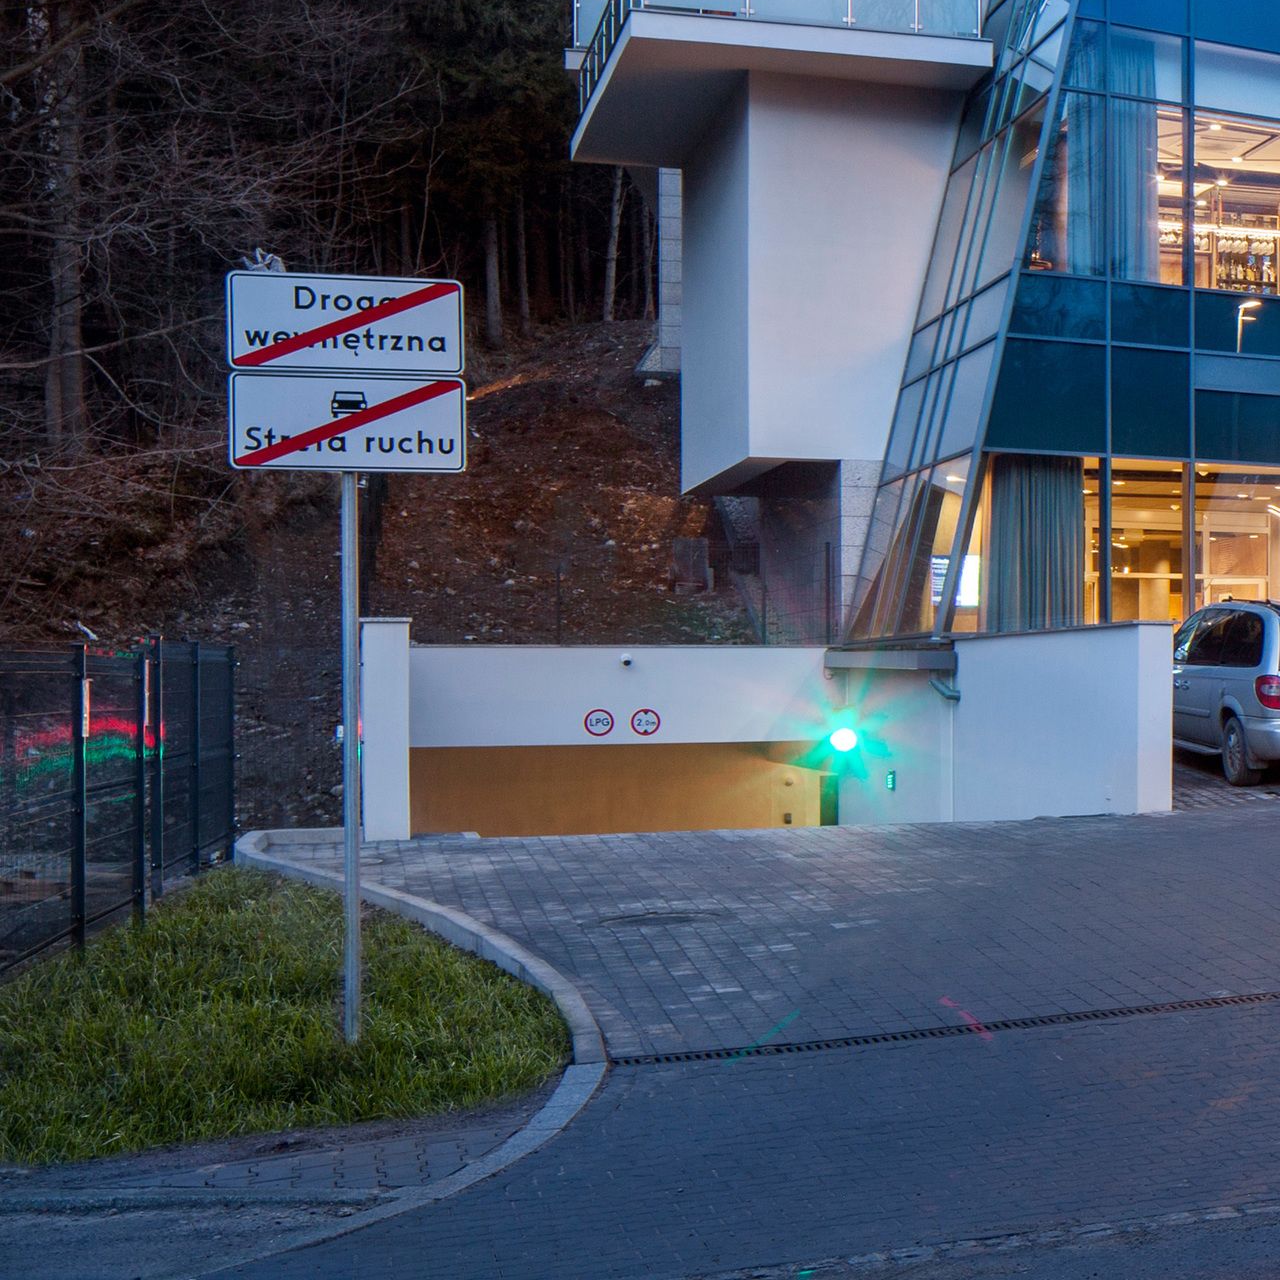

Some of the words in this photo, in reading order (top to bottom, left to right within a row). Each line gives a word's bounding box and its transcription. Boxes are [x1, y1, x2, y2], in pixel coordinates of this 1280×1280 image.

[294, 285, 400, 312] Drog
[365, 430, 455, 455] ruchu
[589, 717, 610, 727] LPG
